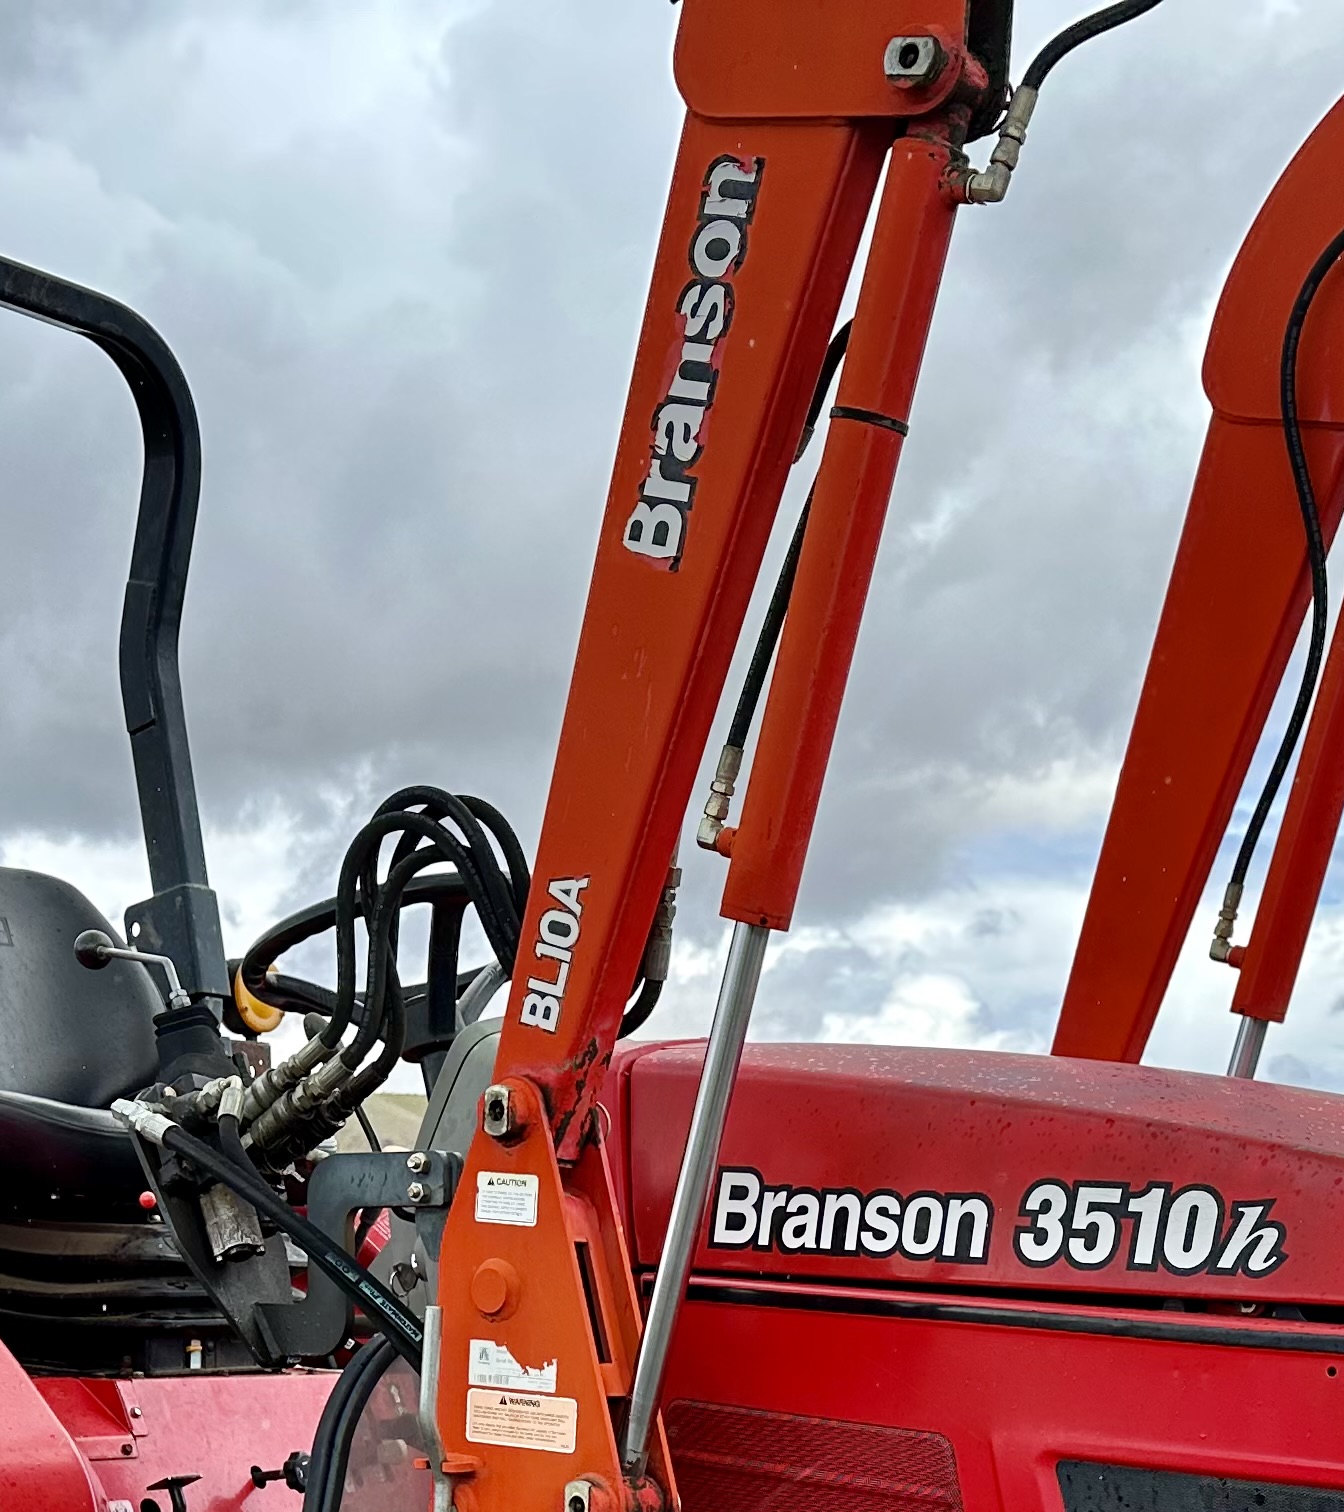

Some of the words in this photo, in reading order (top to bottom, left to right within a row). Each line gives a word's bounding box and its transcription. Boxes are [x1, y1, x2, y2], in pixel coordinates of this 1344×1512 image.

[623, 155, 764, 569] Branson
[519, 876, 590, 1033] BL10A
[496, 1177, 527, 1188] CAUTION
[710, 1168, 992, 1262] Branson
[1015, 1182, 1288, 1275] 3510h
[508, 1396, 541, 1408] WARNING
